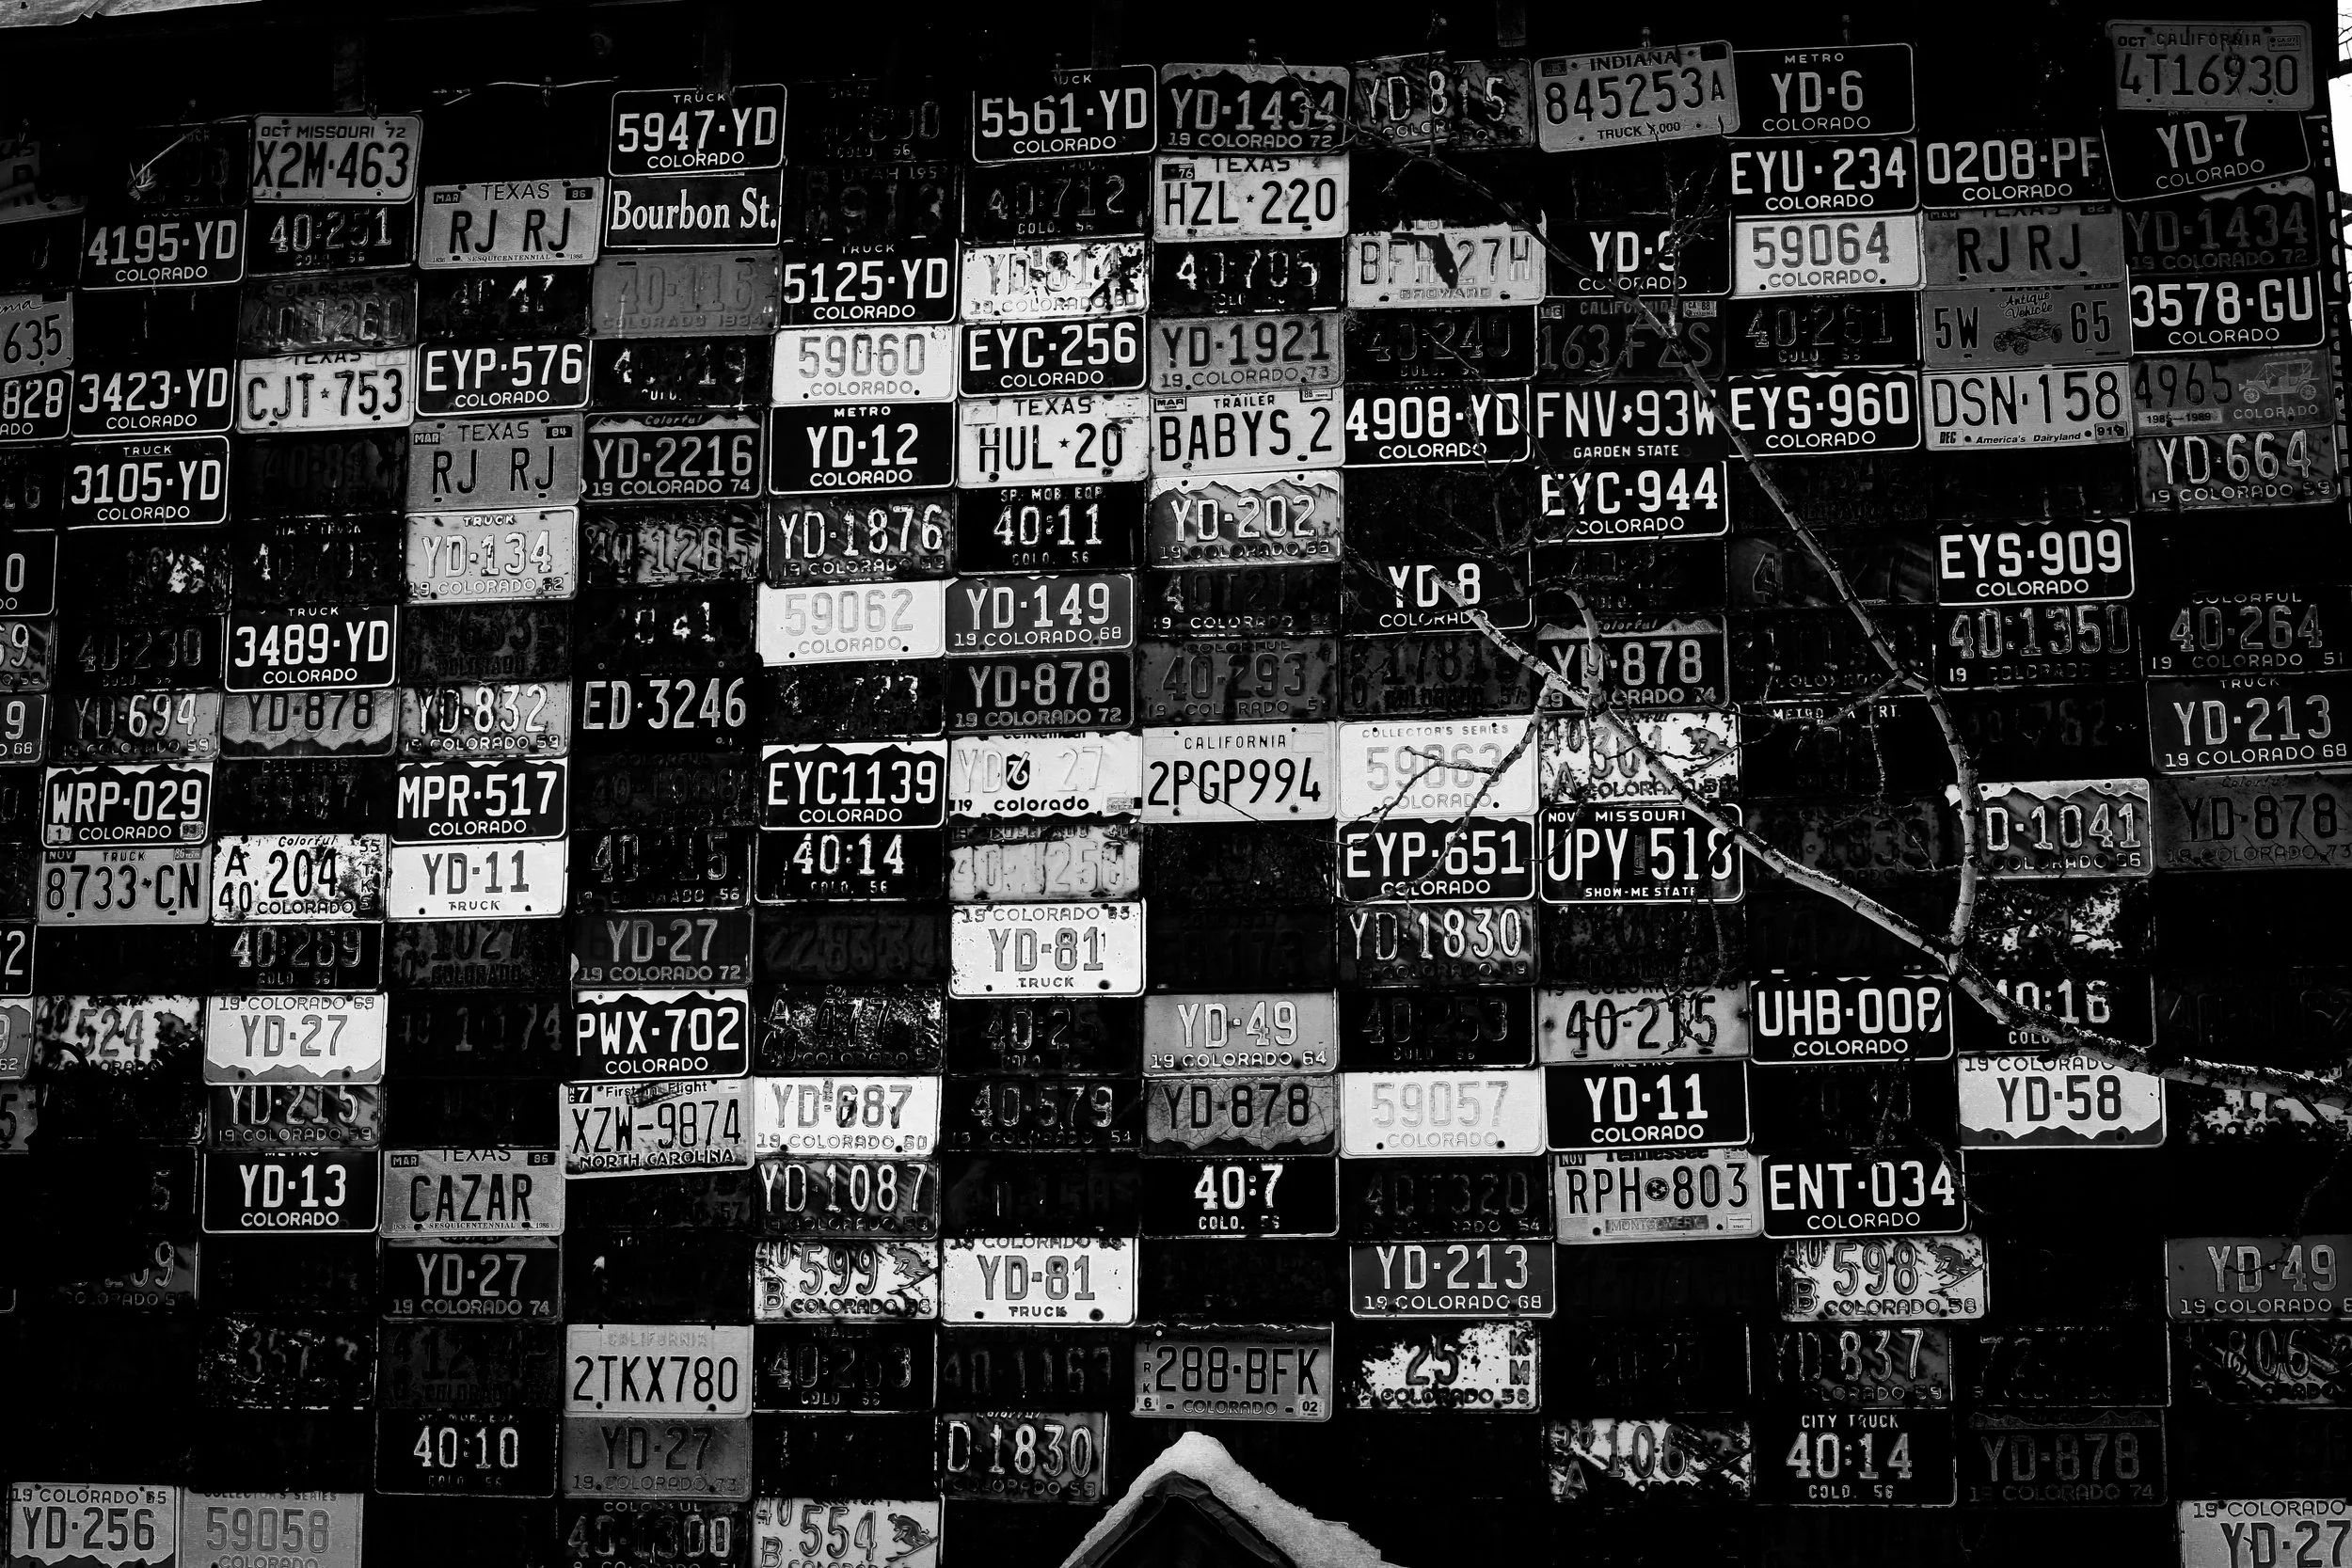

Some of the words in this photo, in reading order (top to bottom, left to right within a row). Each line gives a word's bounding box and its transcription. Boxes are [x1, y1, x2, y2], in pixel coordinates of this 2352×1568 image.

[2118, 36, 2146, 46] OCT
[2156, 31, 2261, 47] CALIFORNIA
[1589, 51, 1677, 72] INDIANA
[1785, 53, 1845, 64] METRO
[2120, 54, 2298, 97] 4T16930
[673, 93, 726, 104] TRUCK
[1545, 67, 1725, 124] 845253A
[261, 126, 291, 138] OCT
[296, 126, 374, 139] MISSOURI
[387, 127, 405, 138] 72
[1597, 124, 1642, 139] TRUCK
[1762, 116, 1870, 133] COLORADO
[1013, 136, 1117, 154] COLORADO
[1168, 132, 1188, 146] 19
[1197, 134, 1302, 149] COLORADO
[1310, 135, 1332, 148] 72
[647, 151, 745, 169] COLORADO
[1213, 156, 1290, 173] TEXAS
[481, 182, 550, 201] TEXAS
[1963, 183, 2072, 201] COLORADO
[612, 189, 731, 230] Bourbon
[739, 187, 777, 230] St.
[1766, 193, 1874, 211] COLORADO
[451, 210, 496, 254] RJ
[523, 207, 570, 254] RJ
[840, 244, 894, 254] TRUCK
[1752, 220, 1889, 268] 59064
[1956, 226, 2010, 274] RJ
[2026, 223, 2080, 272] RJ
[1999, 292, 2050, 309] Antique
[814, 305, 915, 320] COLORADO
[2005, 305, 2053, 320] Vehicle
[1934, 308, 1979, 349] 5W
[2072, 301, 2110, 343] 65
[2169, 328, 2280, 345] COLORADO
[799, 333, 926, 378] 59060
[1000, 371, 1104, 388] COLORADO
[2135, 363, 2233, 408] 4965
[1013, 398, 1092, 416] TEXAS
[1214, 395, 1275, 409] TRAILER
[644, 414, 702, 425] Colorful
[834, 406, 891, 418] METRO
[106, 414, 198, 430] COLORADO
[458, 422, 529, 441] TEXAS
[1159, 409, 1290, 462] BABYS
[1976, 435, 2026, 444] America's
[2033, 433, 2081, 442] Dairyland
[123, 445, 173, 455] TRUCK
[1573, 447, 1629, 459] GARDEN
[1638, 445, 1678, 457] STATE
[433, 449, 477, 493] RJ
[509, 447, 555, 491] RJ
[810, 469, 913, 487] COLORADO
[592, 483, 612, 496] 19
[621, 480, 723, 494] COLORADO
[730, 479, 750, 492] 74
[97, 507, 190, 521] COLORADO
[465, 515, 515, 527] TRUCK
[1976, 579, 2088, 596] COLORADO
[288, 606, 340, 617] TRUCK
[785, 589, 914, 635] 59062
[955, 632, 975, 647] 19
[985, 628, 1091, 647] COLORADO
[1100, 626, 1121, 640] 68
[263, 668, 358, 684] COLORADO
[2219, 677, 2280, 689] TRUCK
[955, 714, 976, 728] 19
[985, 708, 1091, 727] COLORADO
[1099, 707, 1121, 723] 72
[1184, 735, 1286, 749] CALIFORNIA
[2165, 753, 2188, 768] 19
[2197, 746, 2314, 765] COLORADO
[2322, 743, 2347, 758] 68
[769, 760, 936, 805] EYC1139
[1148, 759, 1321, 806] 2PGP994
[994, 797, 1089, 813] colorado
[800, 808, 902, 823] COLORADO
[1548, 812, 1576, 823] NOV
[1597, 810, 1686, 822] MISSOURI
[429, 820, 527, 836] COLORADO
[103, 851, 146, 862] TRUCK
[1548, 829, 1628, 881] UPY
[1584, 888, 1650, 897] SHOW-ME
[449, 899, 500, 911] TRUCK
[1019, 977, 1074, 988] TRUCK
[605, 1058, 707, 1074] COLORADO
[667, 1082, 707, 1095] Flight
[1372, 1082, 1508, 1127] 59057
[571, 1100, 741, 1154] XZW-9874
[1591, 1125, 1704, 1143] COLORADO
[441, 1148, 511, 1162] TEXAS
[580, 1152, 641, 1170] NORTH
[647, 1149, 734, 1166] CAROLINA
[1567, 1168, 1641, 1214] RPH
[1672, 1164, 1747, 1211] 803
[409, 1174, 532, 1222] CAZAR
[241, 1212, 340, 1227] COLORADO
[1807, 1212, 1920, 1230] COLORADO
[573, 1356, 738, 1402] 2TKX780
[1802, 1414, 1836, 1429] CITY
[1848, 1414, 1899, 1429] TRUCK
[206, 1508, 329, 1553] 59058
